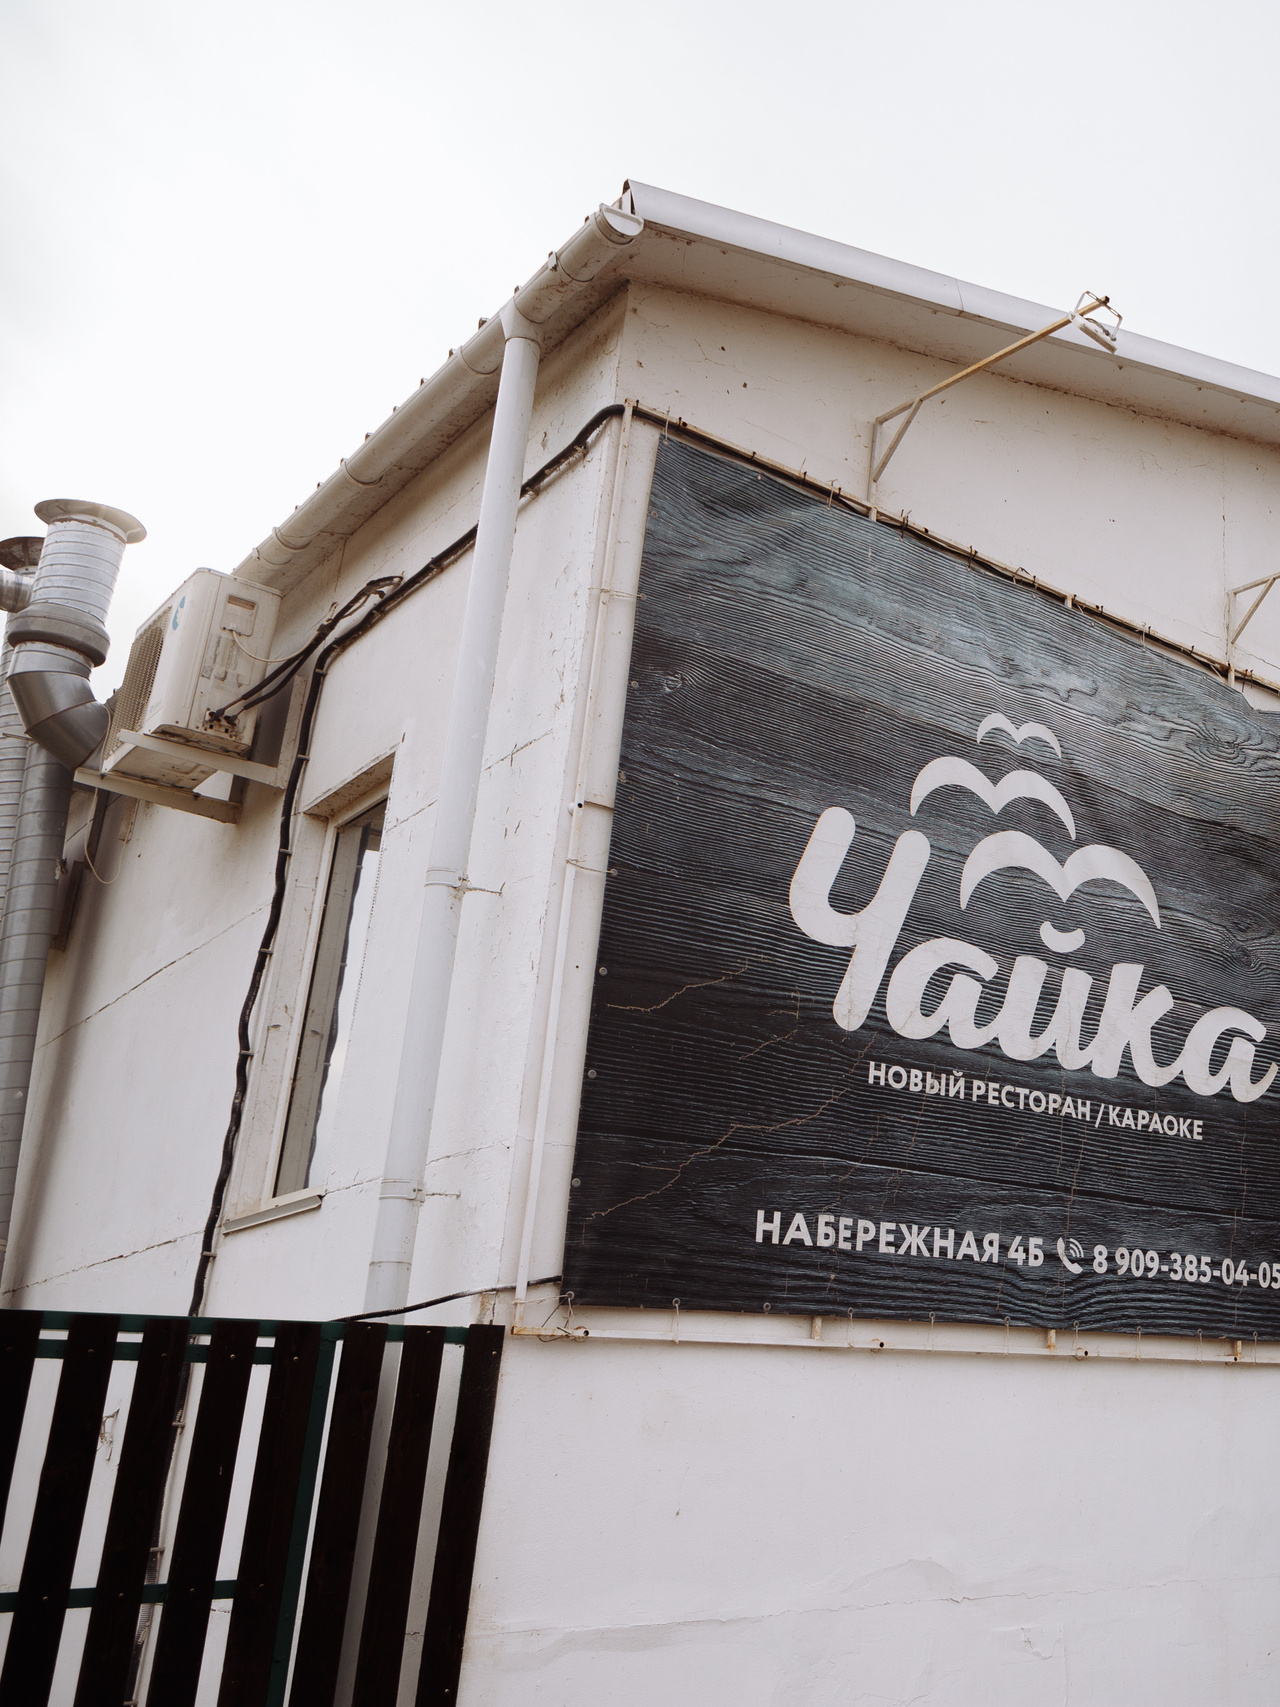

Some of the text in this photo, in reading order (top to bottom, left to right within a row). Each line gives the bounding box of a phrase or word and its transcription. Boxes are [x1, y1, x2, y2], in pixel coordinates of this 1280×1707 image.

[789, 806, 1279, 1102] Чайка
[868, 1060, 966, 1100] НОВЫЙ
[971, 1079, 1092, 1122] РЕСТОРАН
[755, 1209, 1000, 1264] НАБЕРЕЖНАЯ
[1007, 1235, 1044, 1267] 4Б
[1092, 1244, 1109, 1274] 8
